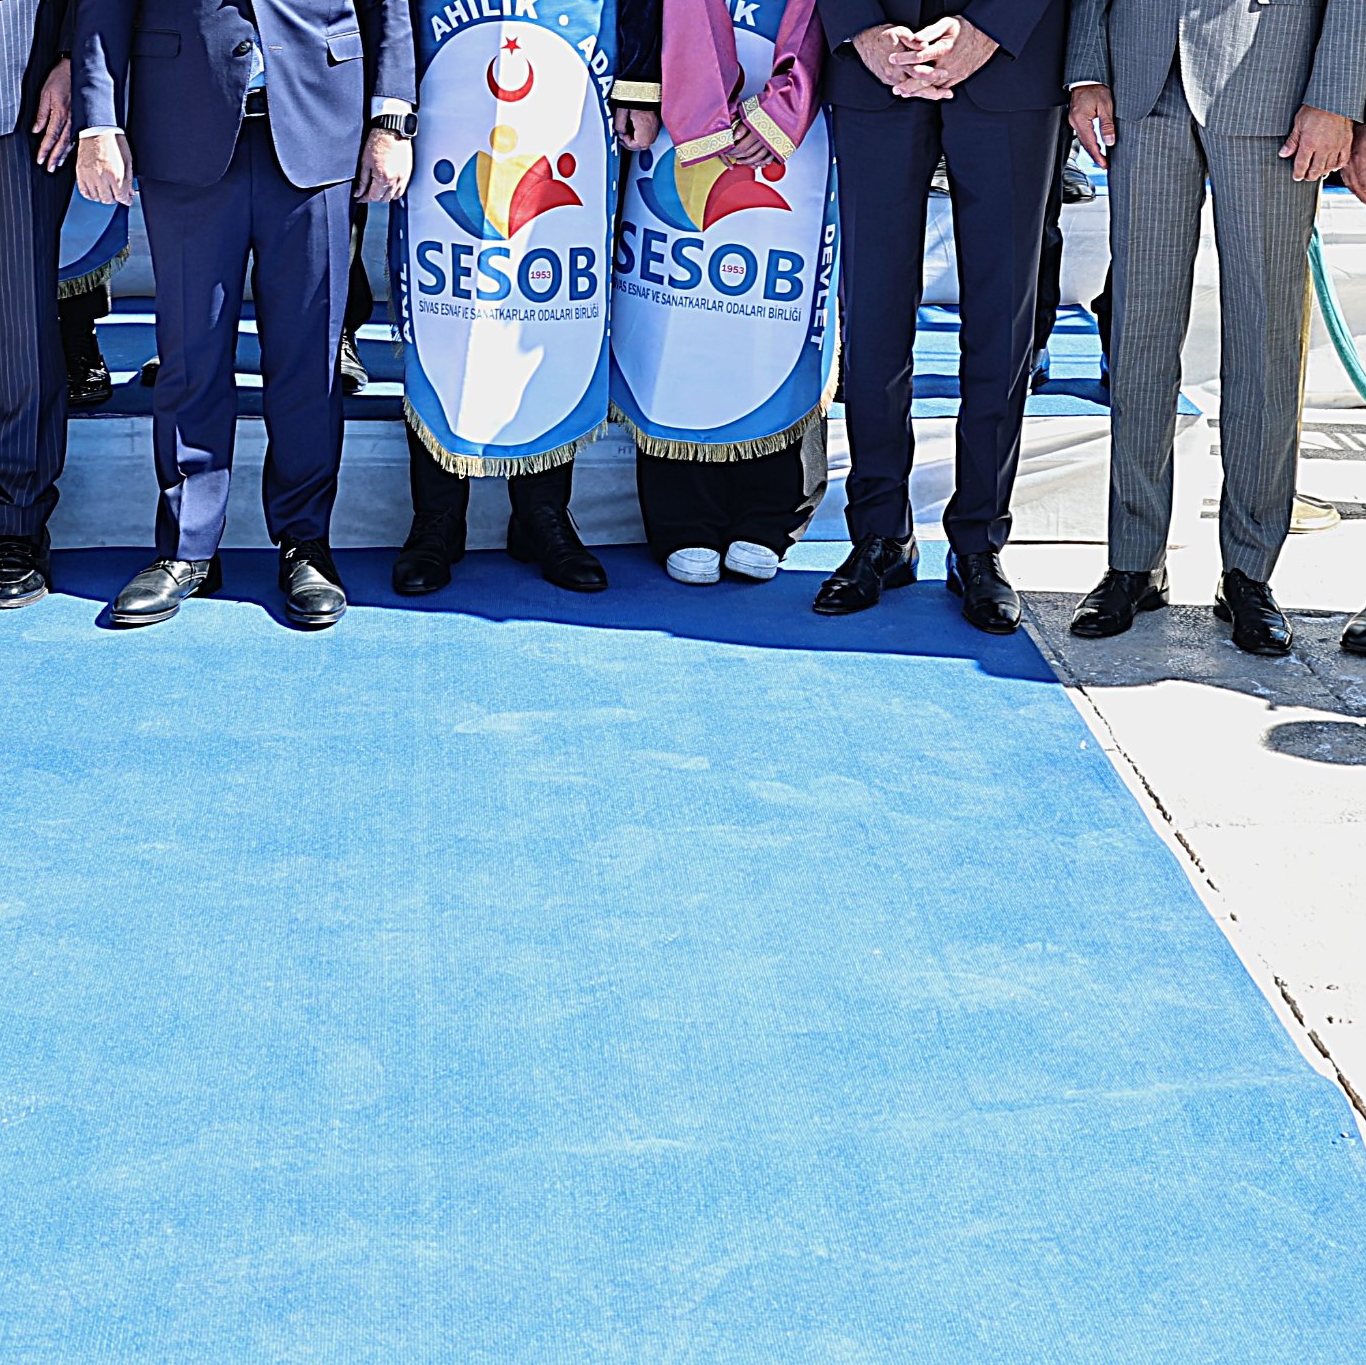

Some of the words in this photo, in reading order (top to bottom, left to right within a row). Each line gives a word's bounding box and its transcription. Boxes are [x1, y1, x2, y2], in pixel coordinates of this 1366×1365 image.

[416, 240, 598, 304] SESOB
[530, 270, 552, 279] 1953
[614, 221, 806, 303] SESOB
[721, 264, 745, 275] 1953
[628, 282, 650, 300] ESNAF
[651, 289, 662, 303] VE
[662, 293, 724, 313] SANATKARLAR
[726, 301, 766, 318] ODALARI
[768, 305, 802, 322] BİRLİĞİ
[809, 223, 836, 351] DEVLET
[418, 298, 440, 314] SİVAS
[440, 302, 462, 318] ESNAF
[538, 307, 573, 322] ODALARI
[575, 302, 600, 321] BİRLİĞİ
